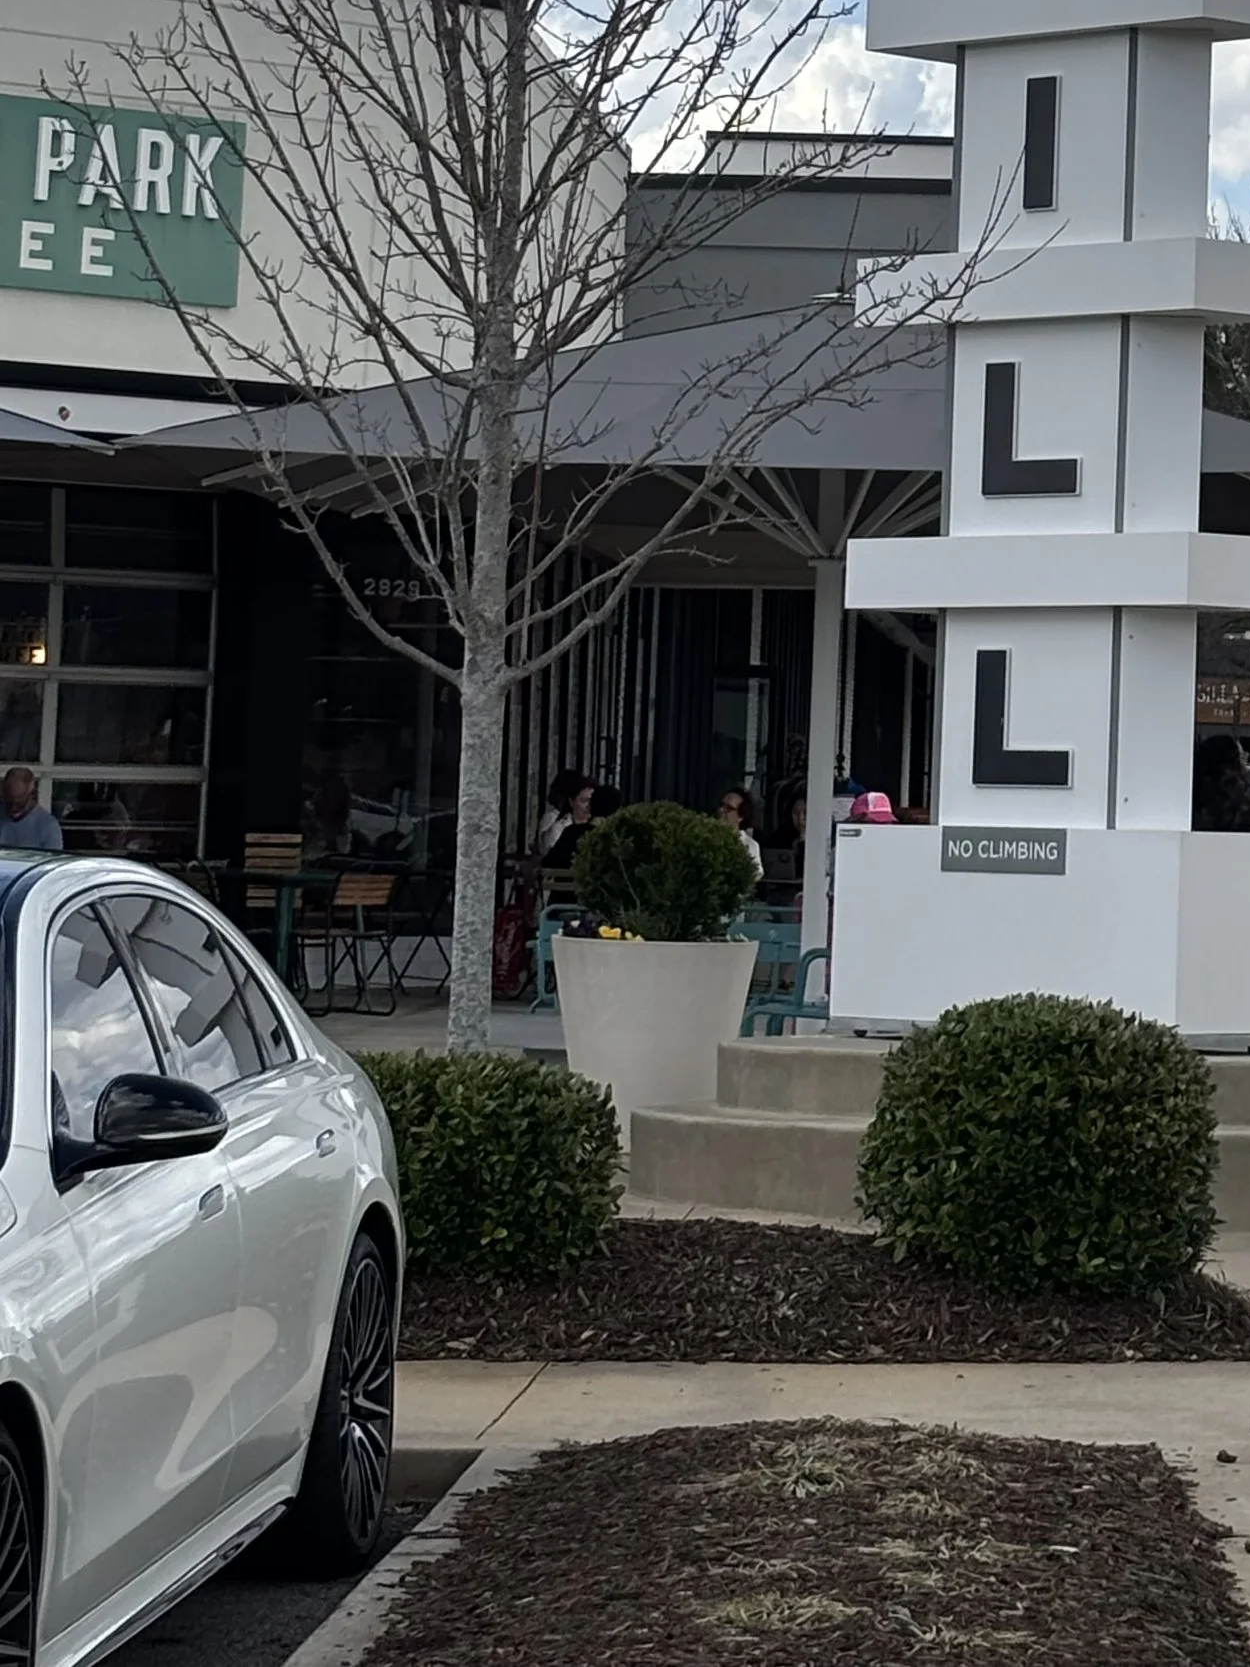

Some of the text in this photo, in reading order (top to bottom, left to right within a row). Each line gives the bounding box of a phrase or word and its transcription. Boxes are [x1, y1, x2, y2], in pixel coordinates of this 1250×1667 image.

[33, 116, 224, 220] PARK
[948, 839, 1058, 860] NO CLIMBING
